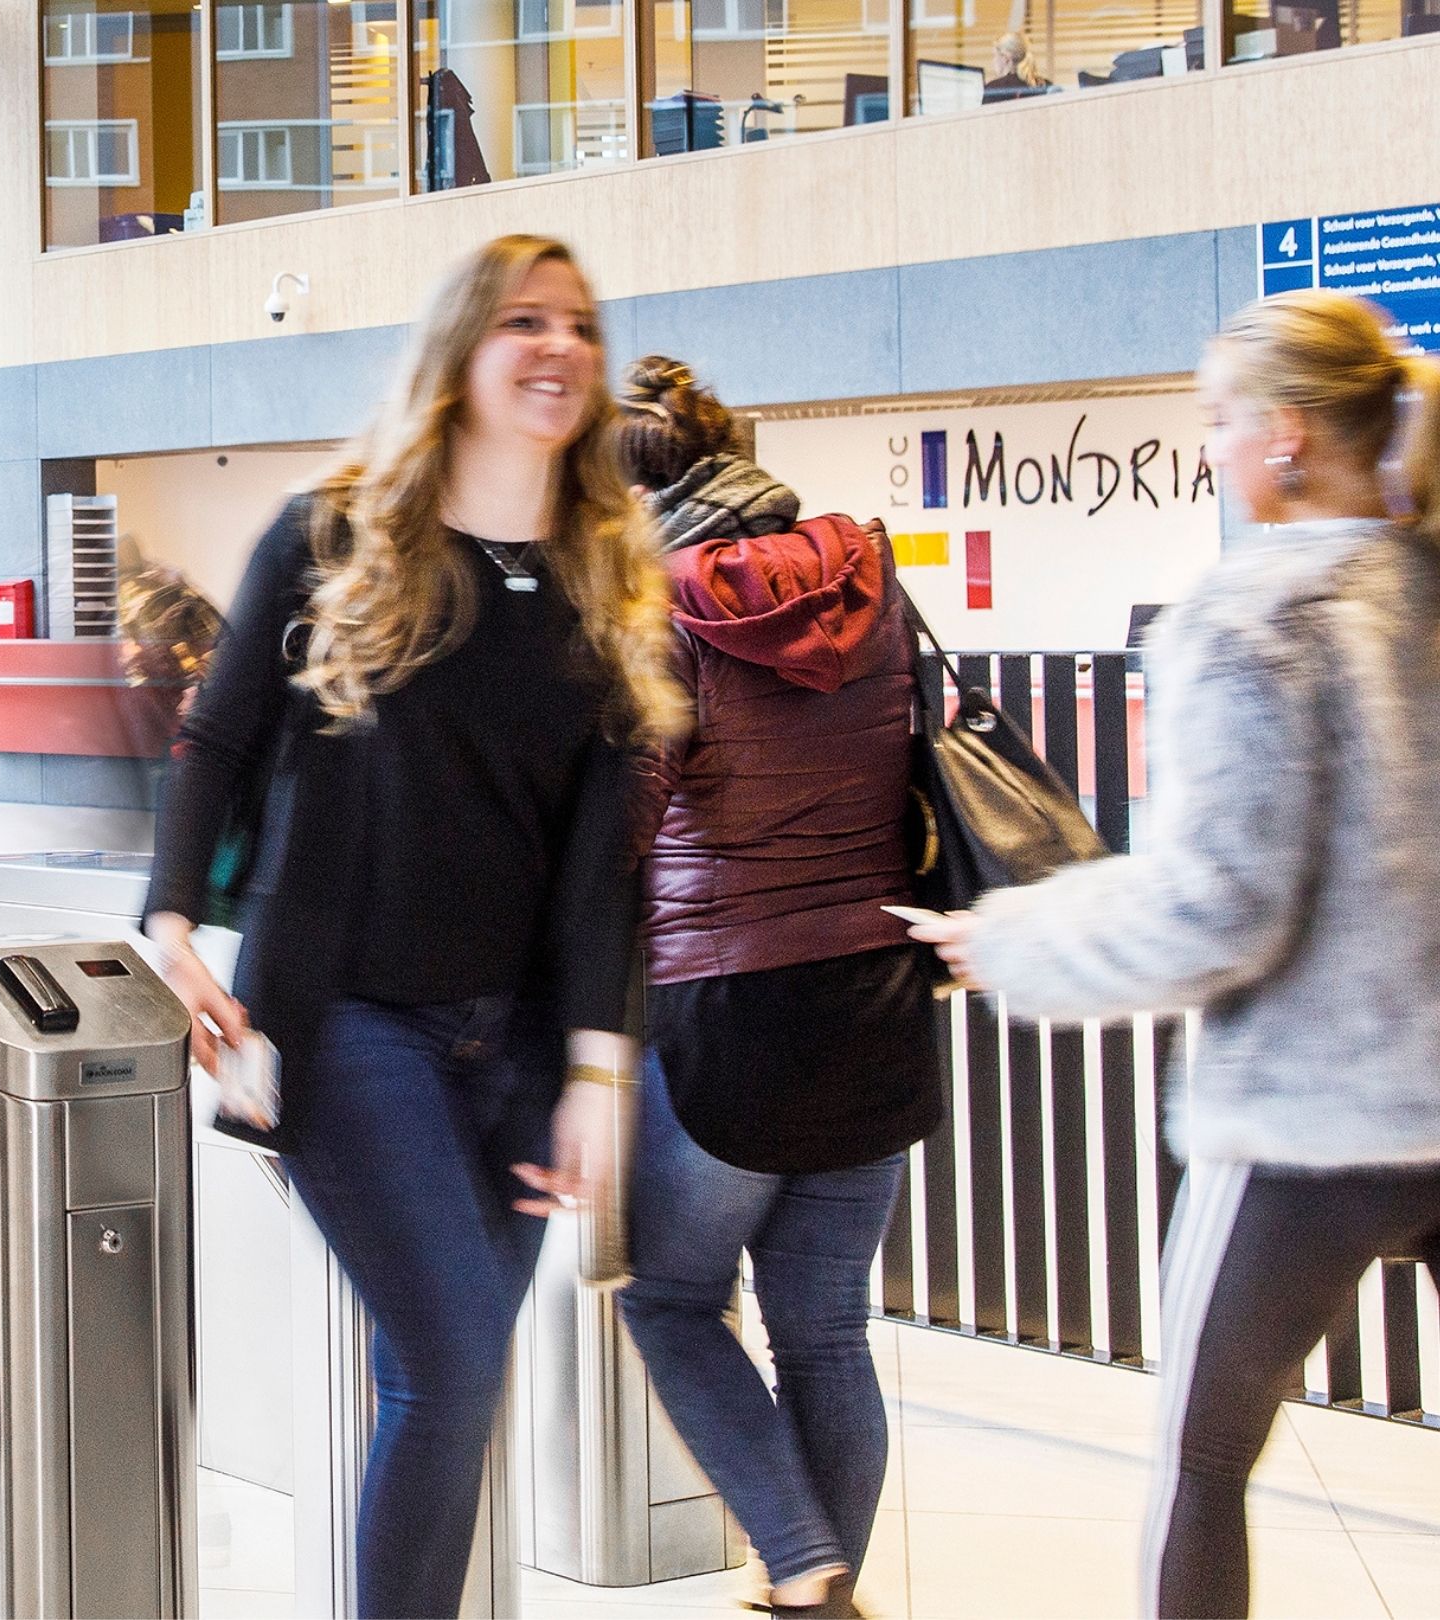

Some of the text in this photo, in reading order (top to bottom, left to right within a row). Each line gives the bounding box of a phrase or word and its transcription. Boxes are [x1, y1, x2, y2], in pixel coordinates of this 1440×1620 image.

[1323, 217, 1354, 233] School
[1355, 218, 1376, 229] voor
[1278, 226, 1298, 258] 4
[1324, 261, 1355, 277] School
[1355, 262, 1376, 273] voor
[888, 434, 909, 508] roc
